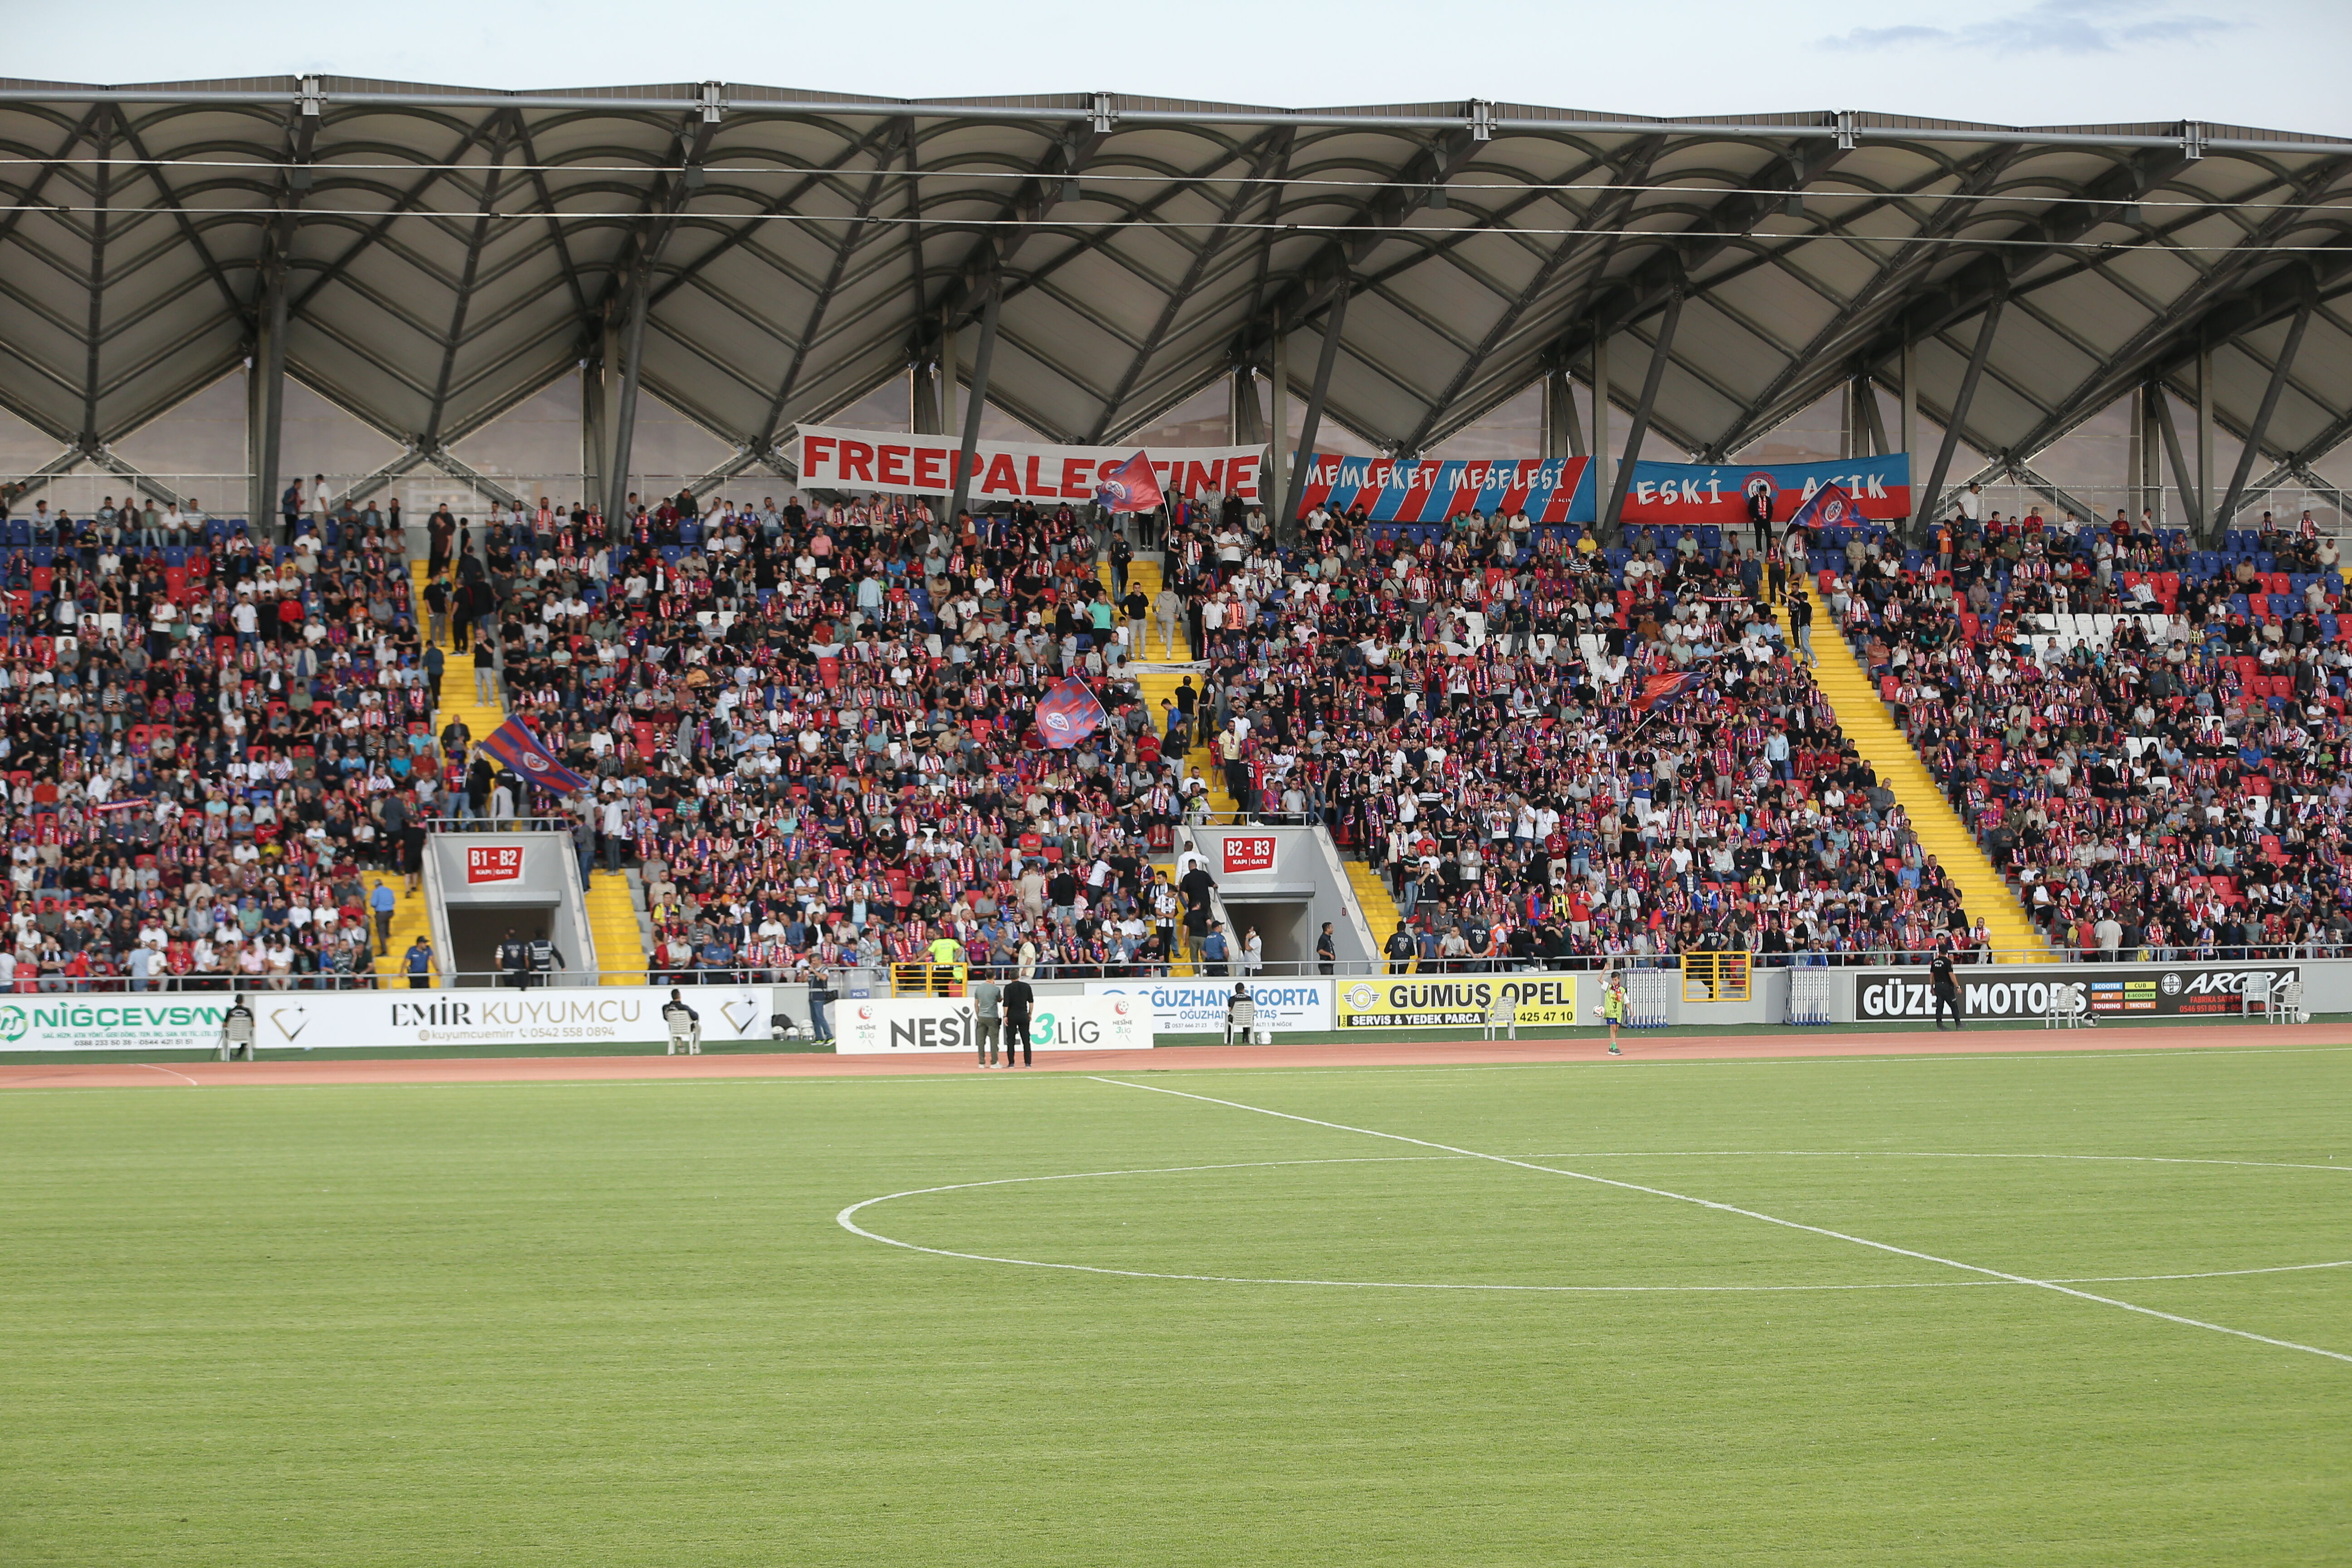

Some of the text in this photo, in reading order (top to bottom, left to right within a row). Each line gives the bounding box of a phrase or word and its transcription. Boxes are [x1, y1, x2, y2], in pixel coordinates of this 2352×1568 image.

[1304, 460, 1564, 490] MEMLEKET MESELESİ
[1637, 470, 1887, 505] ESKİ AIK
[471, 850, 488, 866] B1
[500, 849, 517, 866] B2
[1227, 840, 1243, 857] B2
[1254, 840, 1270, 856] B3
[1138, 985, 1320, 1007] ĞUZHAN İGORTA
[1389, 982, 1569, 1008] GÜMÜŞ OPEL
[1863, 978, 1952, 1016] GÜZE
[2190, 995, 2216, 1003] FABRİKA
[392, 996, 640, 1026] EMİR KUYUMCU
[1395, 1014, 1403, 1025] &
[1406, 1014, 1442, 1024] YEDEK
[1520, 1012, 1539, 1022] 425
[1544, 1012, 1556, 1021] 47
[1561, 1011, 1573, 1021] 10
[530, 1027, 559, 1038] 0542
[563, 1027, 583, 1037] 558
[587, 1027, 615, 1037] 0894
